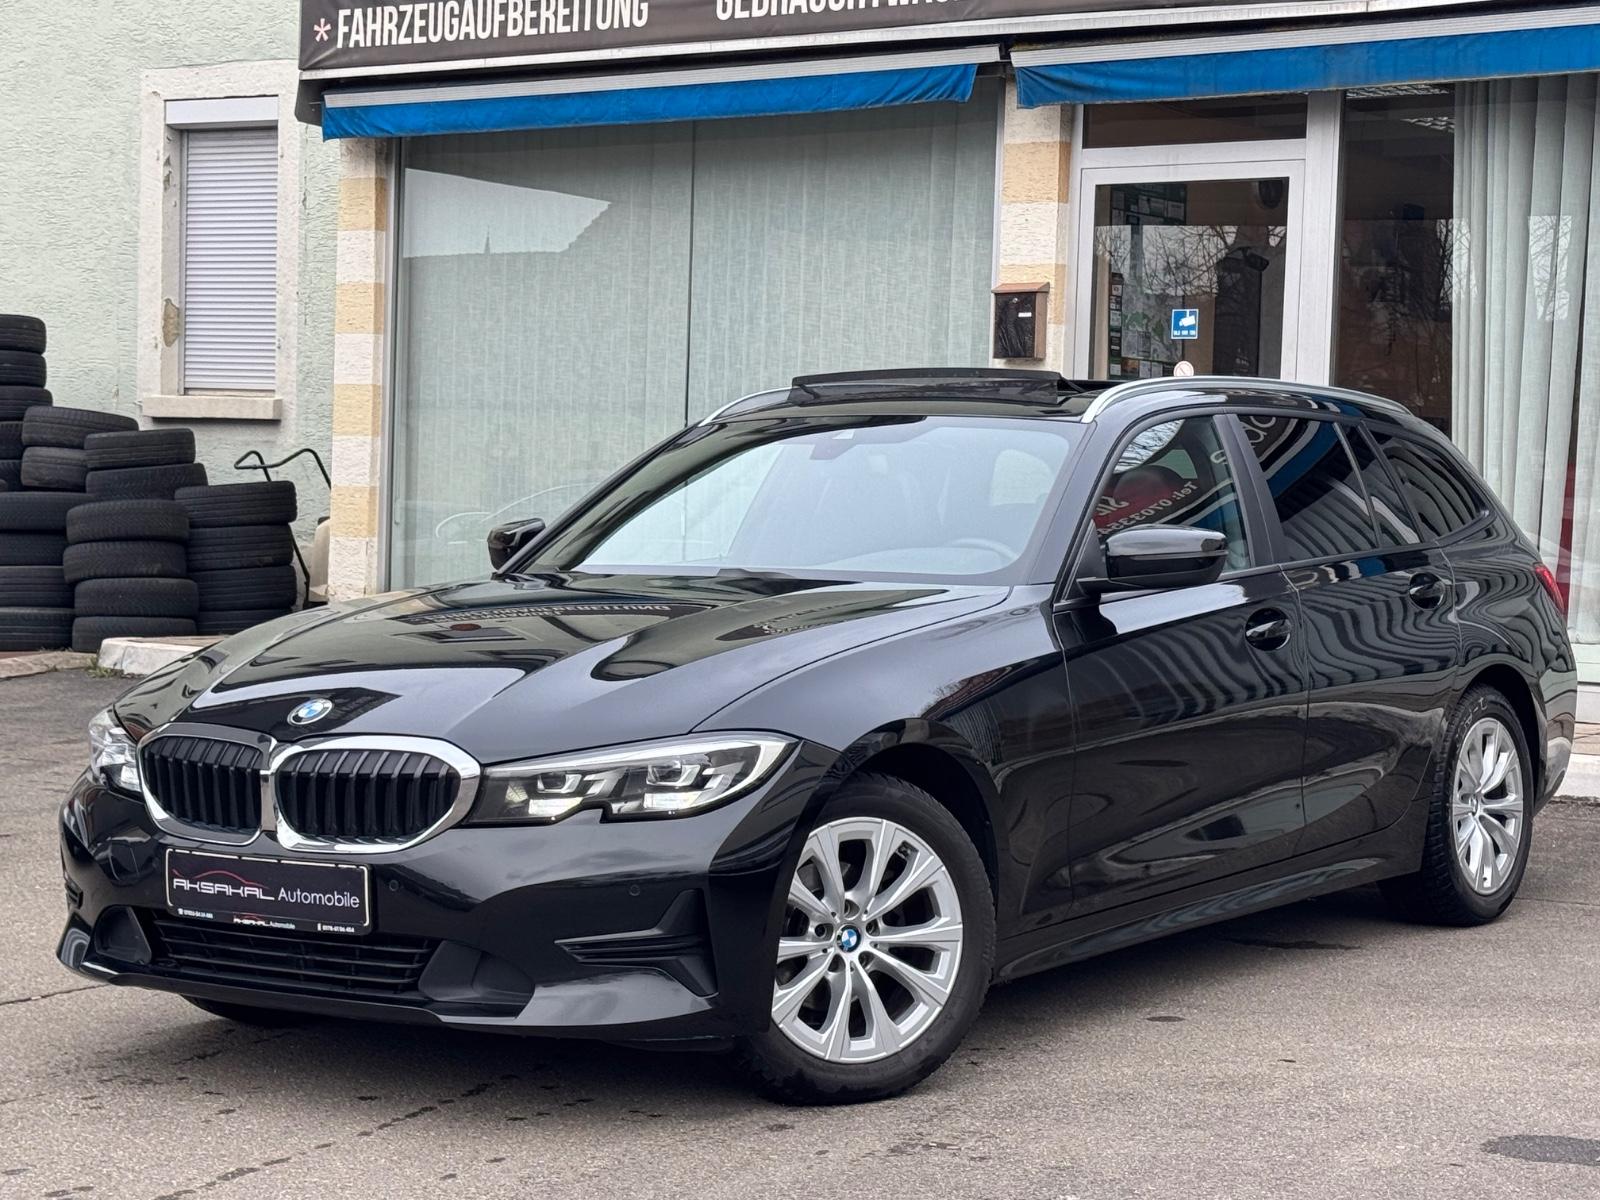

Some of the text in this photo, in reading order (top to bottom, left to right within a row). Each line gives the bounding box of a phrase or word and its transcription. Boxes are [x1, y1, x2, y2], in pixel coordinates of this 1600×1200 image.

[337, 0, 649, 48] FAHRZEUGAUFBEREITUNG
[173, 878, 360, 908] AKSAKAL Automobile
